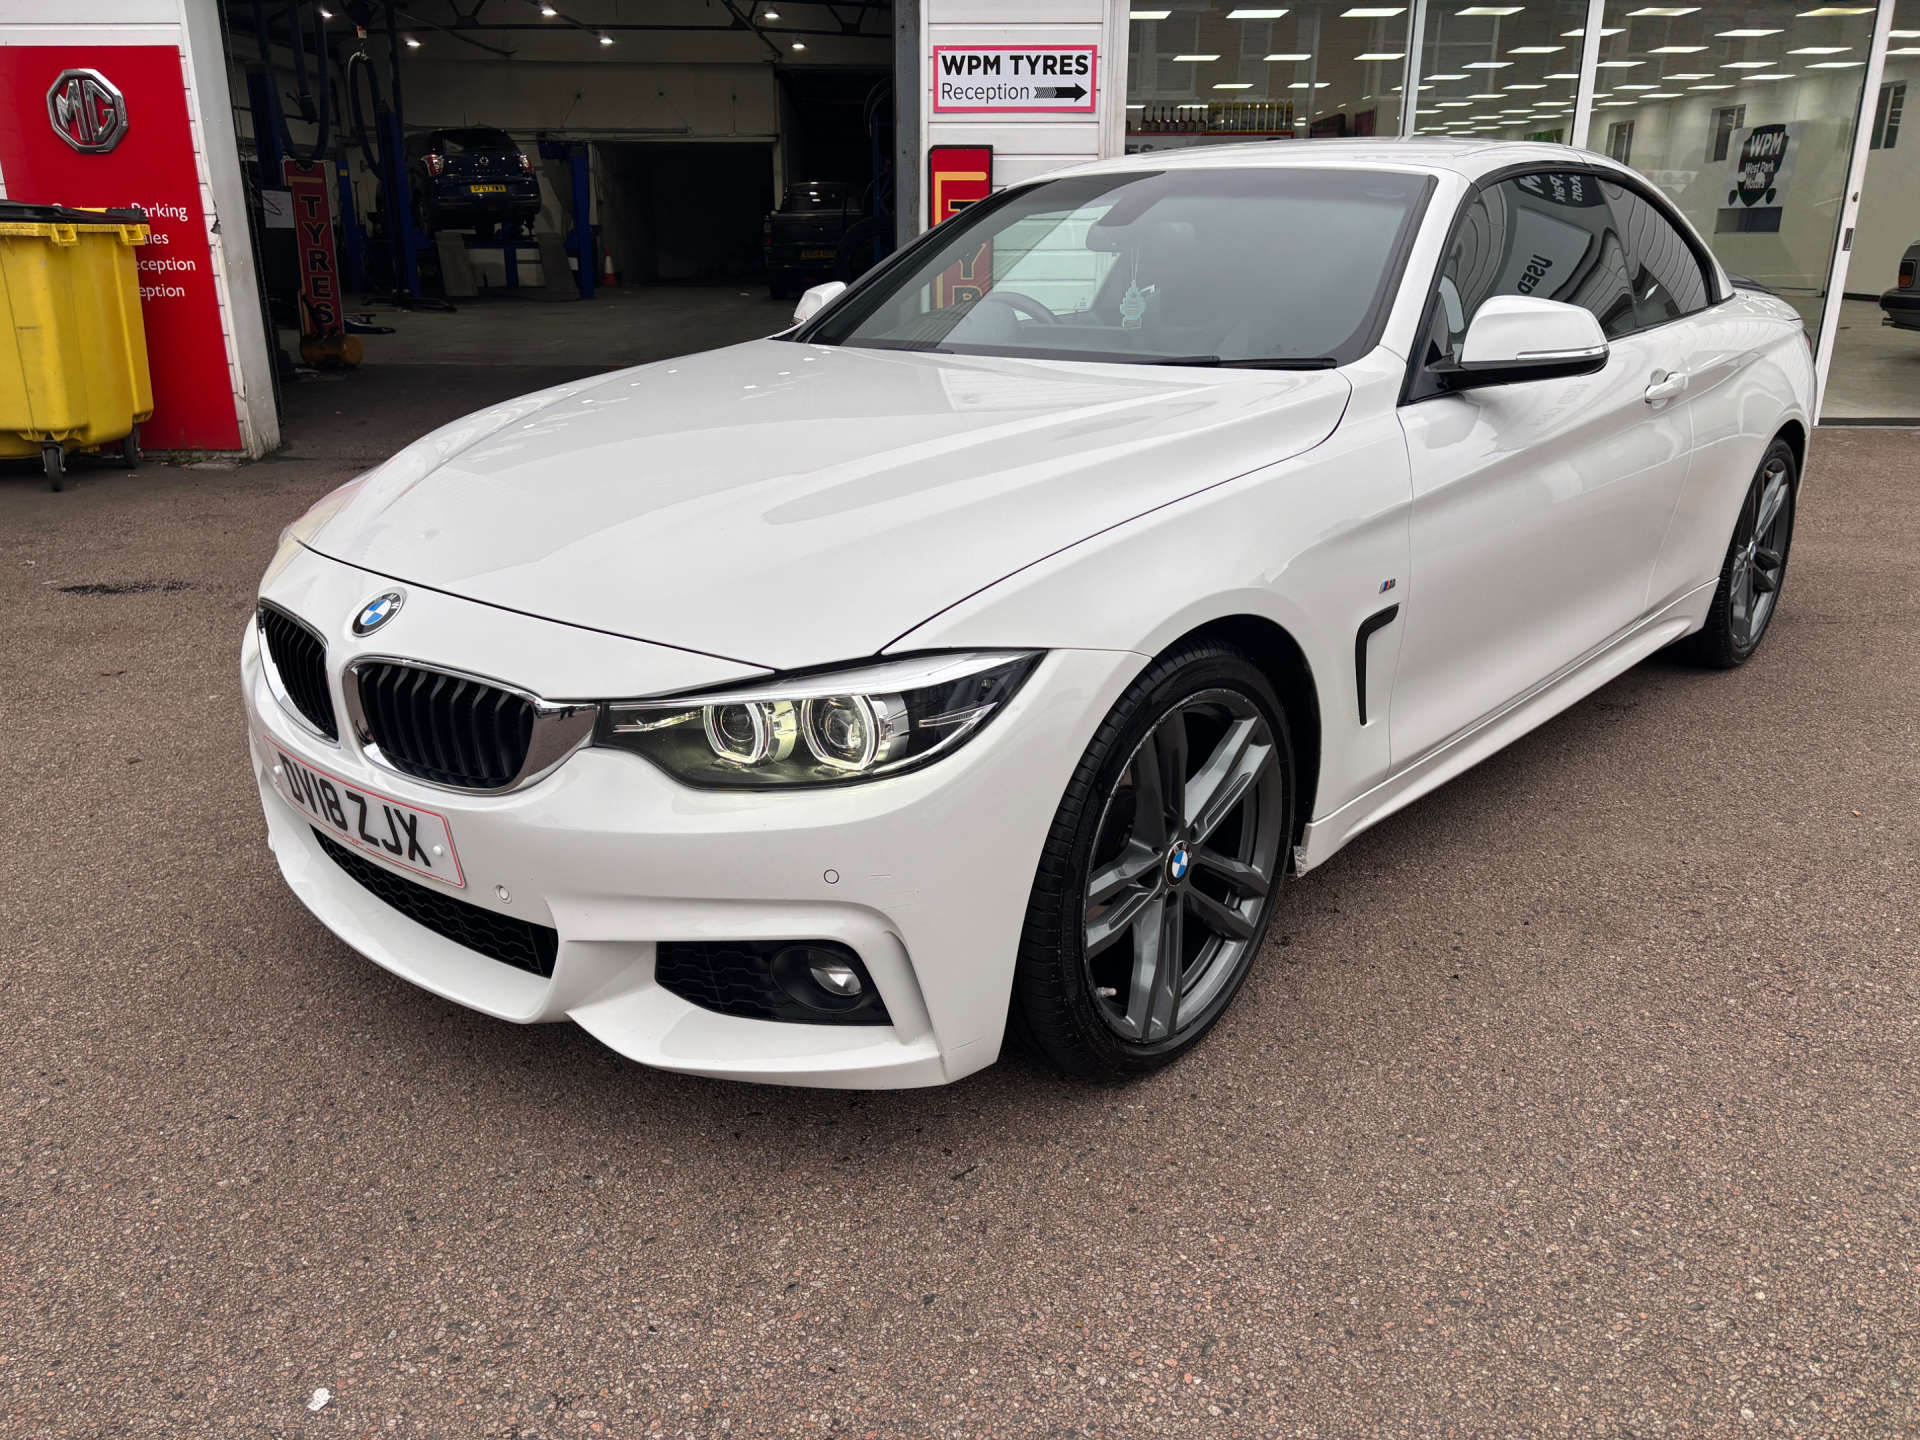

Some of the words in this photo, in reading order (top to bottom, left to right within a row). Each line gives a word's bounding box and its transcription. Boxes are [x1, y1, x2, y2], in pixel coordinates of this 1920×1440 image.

[941, 55, 1001, 76] WPM
[1009, 54, 1089, 76] TYRES
[941, 82, 1030, 104] Reception
[55, 78, 117, 143] MG
[1749, 131, 1784, 157] WPM
[1760, 160, 1775, 173] Park
[143, 232, 169, 245] ales
[300, 193, 335, 326] TYRES
[139, 284, 185, 301] eption
[278, 751, 348, 831] DV18
[345, 790, 432, 867] ZJX
